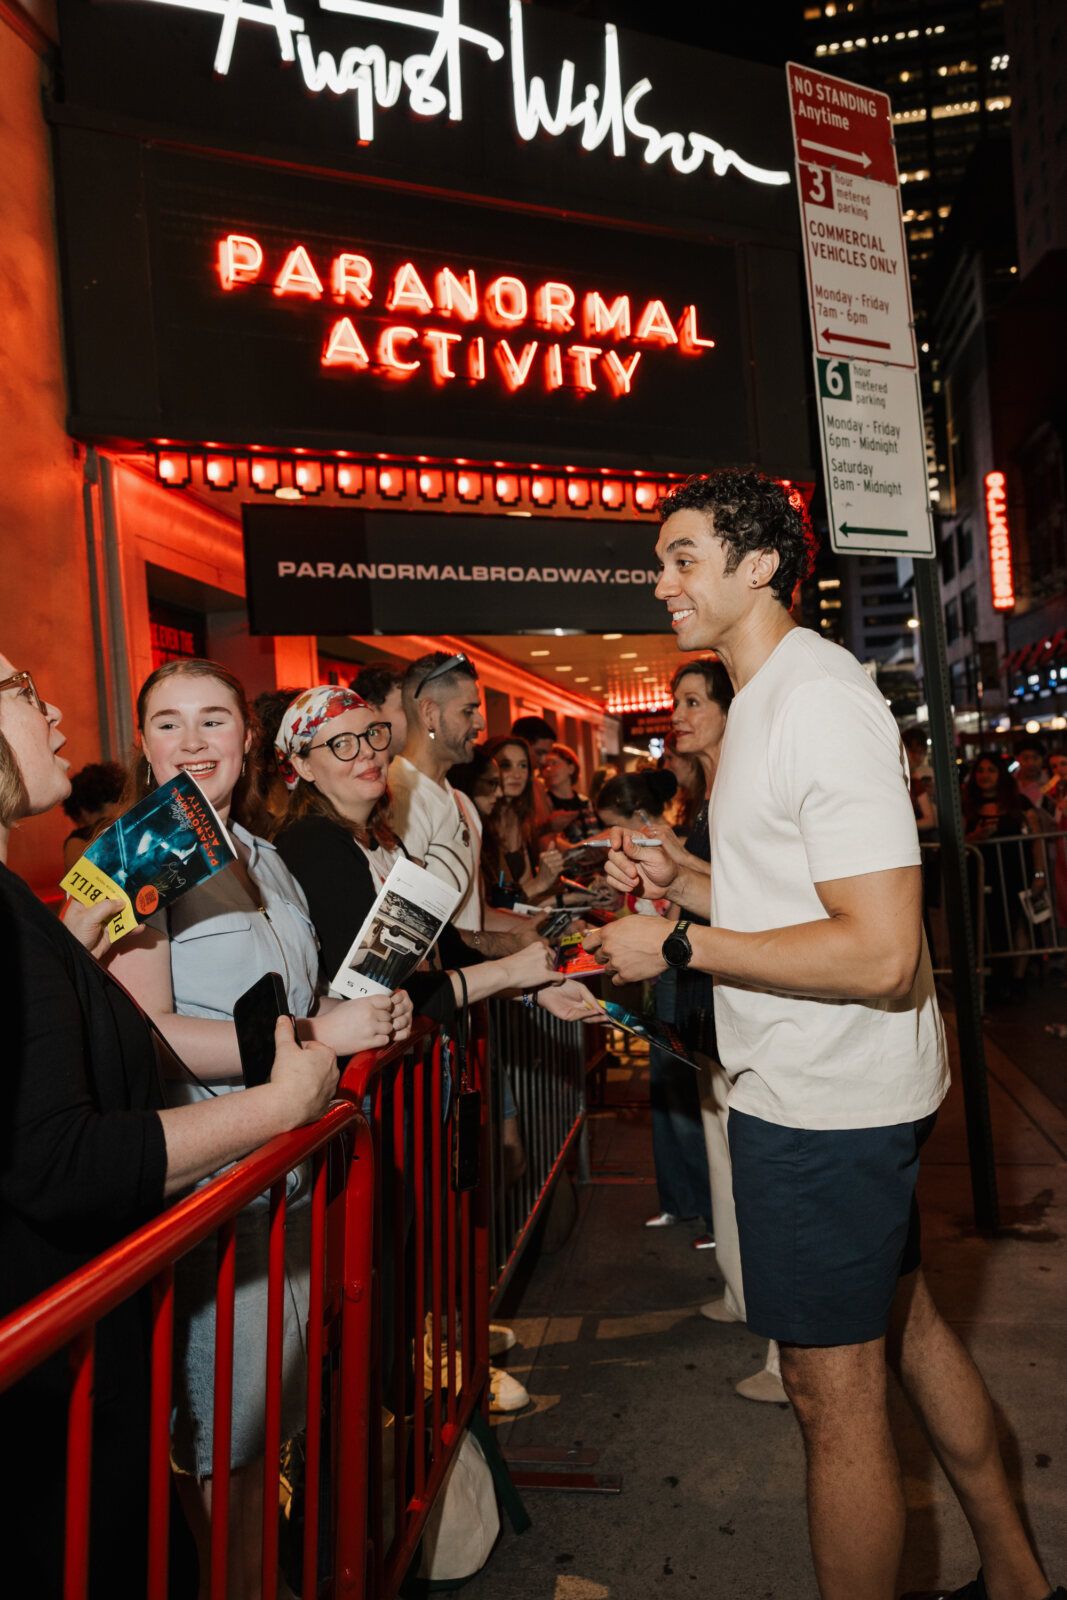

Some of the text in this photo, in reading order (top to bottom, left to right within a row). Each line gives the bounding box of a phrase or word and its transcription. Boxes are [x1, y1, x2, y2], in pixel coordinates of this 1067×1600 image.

[794, 75, 877, 118] NO STANDING
[798, 99, 850, 131] Anytime
[808, 165, 826, 203] 3
[835, 173, 853, 188] hour
[837, 187, 871, 206] metered
[837, 202, 869, 221] parking
[809, 220, 885, 252] COMMERCIAL
[811, 241, 897, 275] VEHICLES ONLY
[219, 235, 715, 348] PARANORMAL
[814, 284, 853, 307] Monday
[861, 293, 890, 315] Friday
[817, 302, 838, 319] 7am
[847, 308, 868, 326] 6pm
[322, 316, 642, 394] ACTIVITY
[826, 361, 844, 396] 6
[853, 364, 871, 378] hour
[855, 379, 888, 394] metered
[856, 394, 886, 409] parking
[826, 414, 863, 435] Monday
[873, 420, 900, 440] Friday
[829, 433, 850, 451] 6pm
[860, 438, 898, 456] Midnight
[831, 458, 873, 478] Saturday
[833, 476, 854, 492] 8am
[863, 480, 902, 498] Midnight
[277, 560, 662, 584] PARANORMALBROADWAY.COM
[170, 787, 220, 867] PARANORMAL
[187, 795, 220, 847] ACTIVITY
[70, 871, 125, 935] PLBILL
